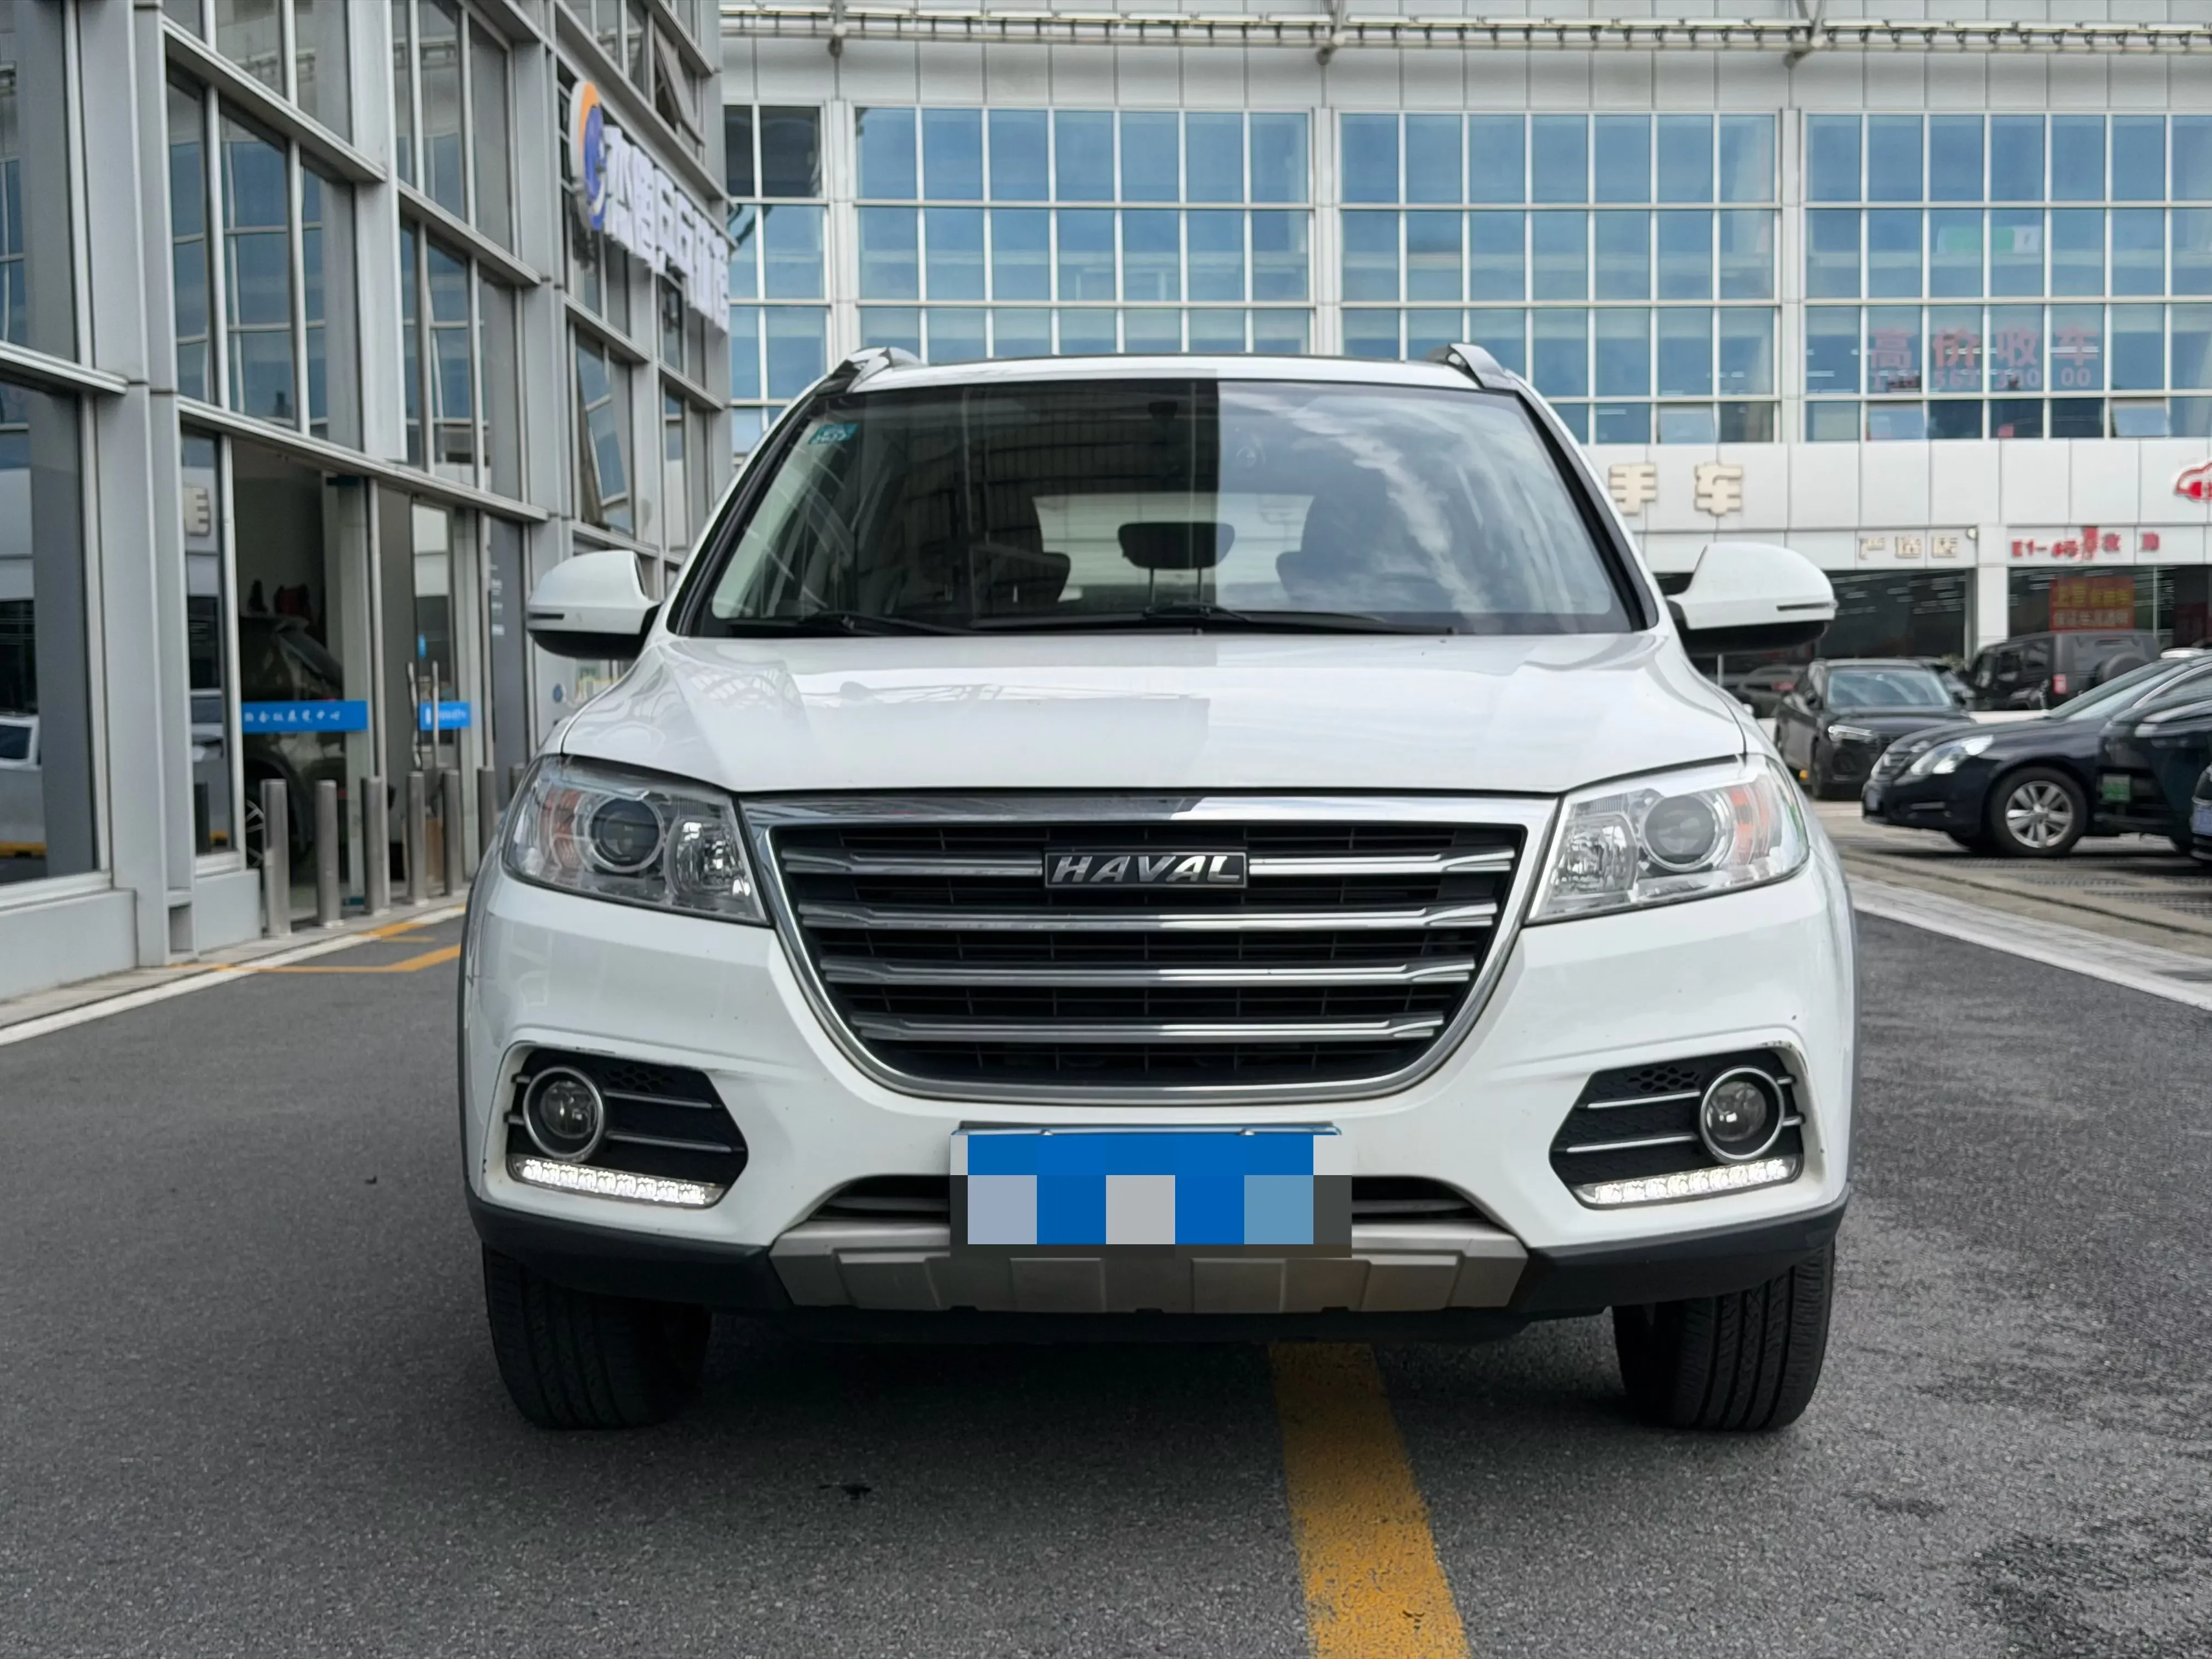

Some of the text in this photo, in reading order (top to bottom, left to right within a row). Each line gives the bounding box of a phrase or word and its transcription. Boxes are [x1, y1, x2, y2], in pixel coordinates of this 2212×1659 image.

[1871, 325, 2099, 366] 高价收车
[1051, 855, 1240, 883] HAVAL
